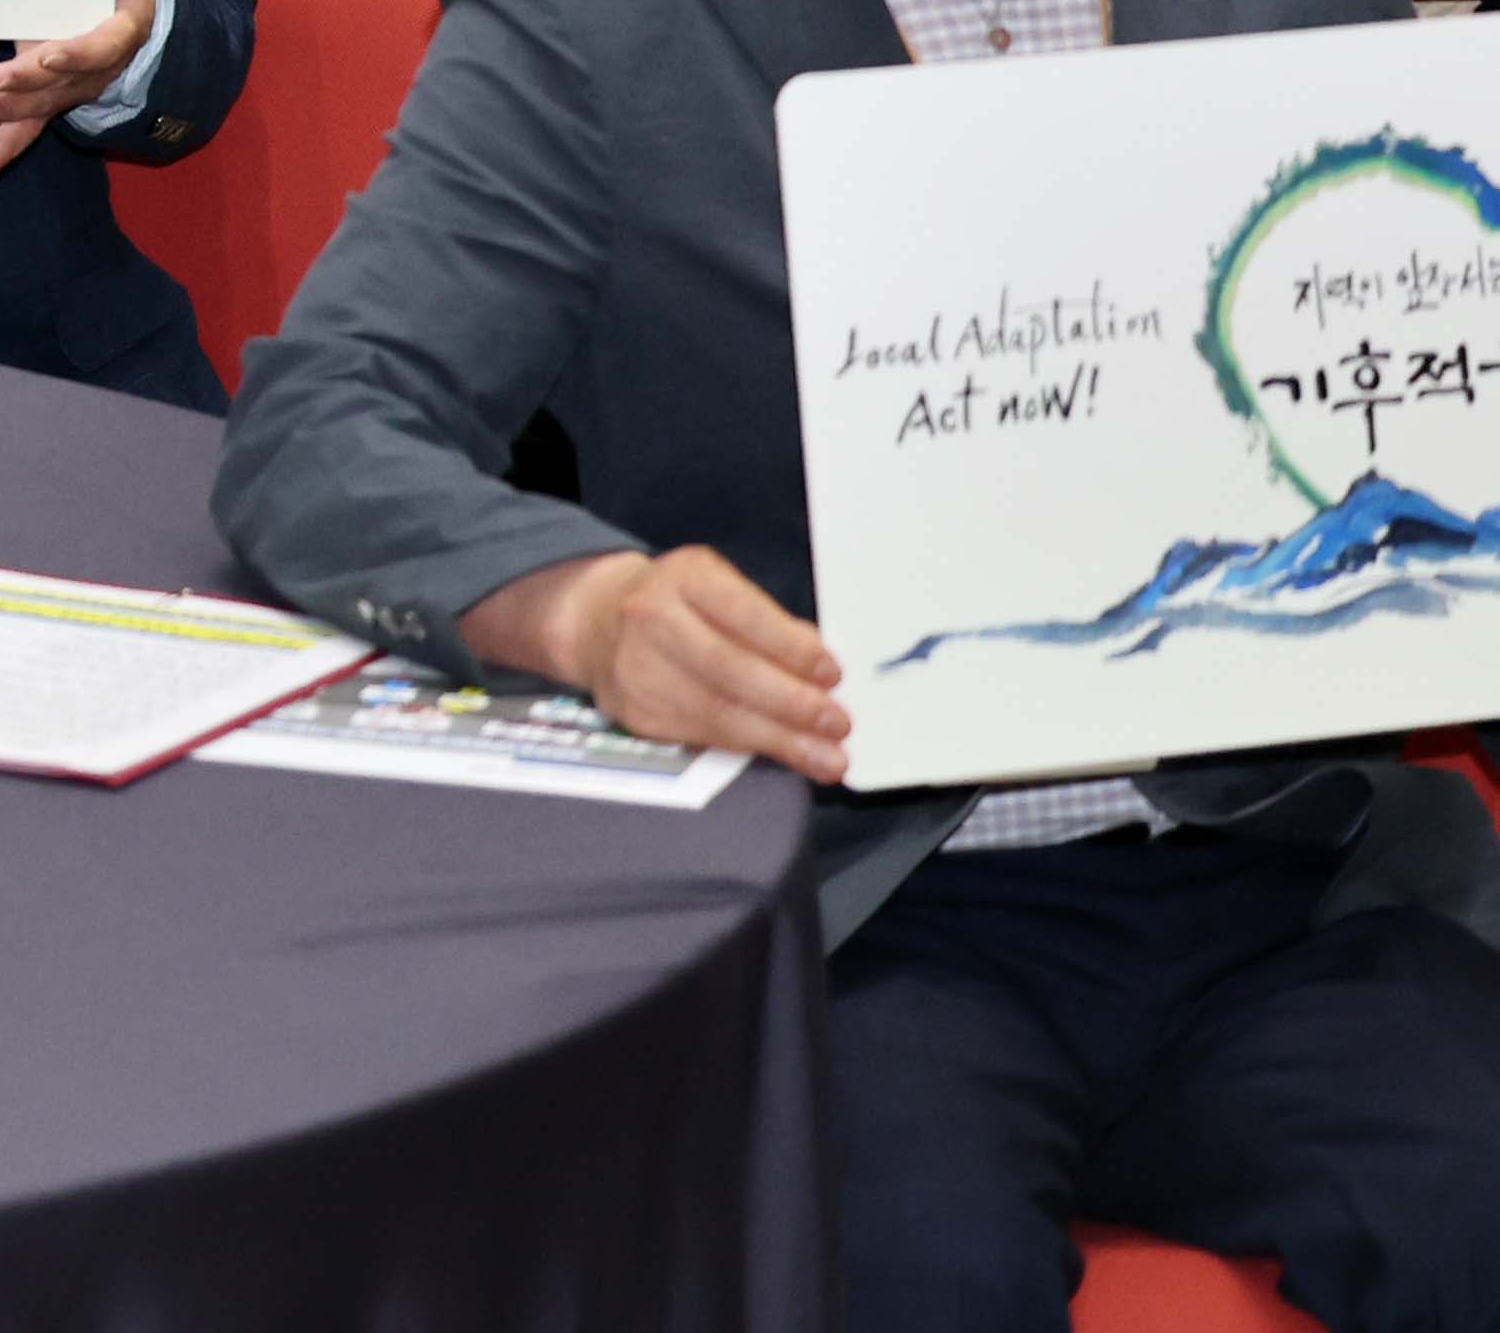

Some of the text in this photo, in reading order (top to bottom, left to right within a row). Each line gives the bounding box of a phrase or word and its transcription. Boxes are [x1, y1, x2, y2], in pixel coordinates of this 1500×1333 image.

[835, 279, 1163, 380] Local Adaptation
[1294, 262, 1382, 331] 지역이
[897, 371, 986, 444] Act
[1261, 338, 1500, 455] 기후적
